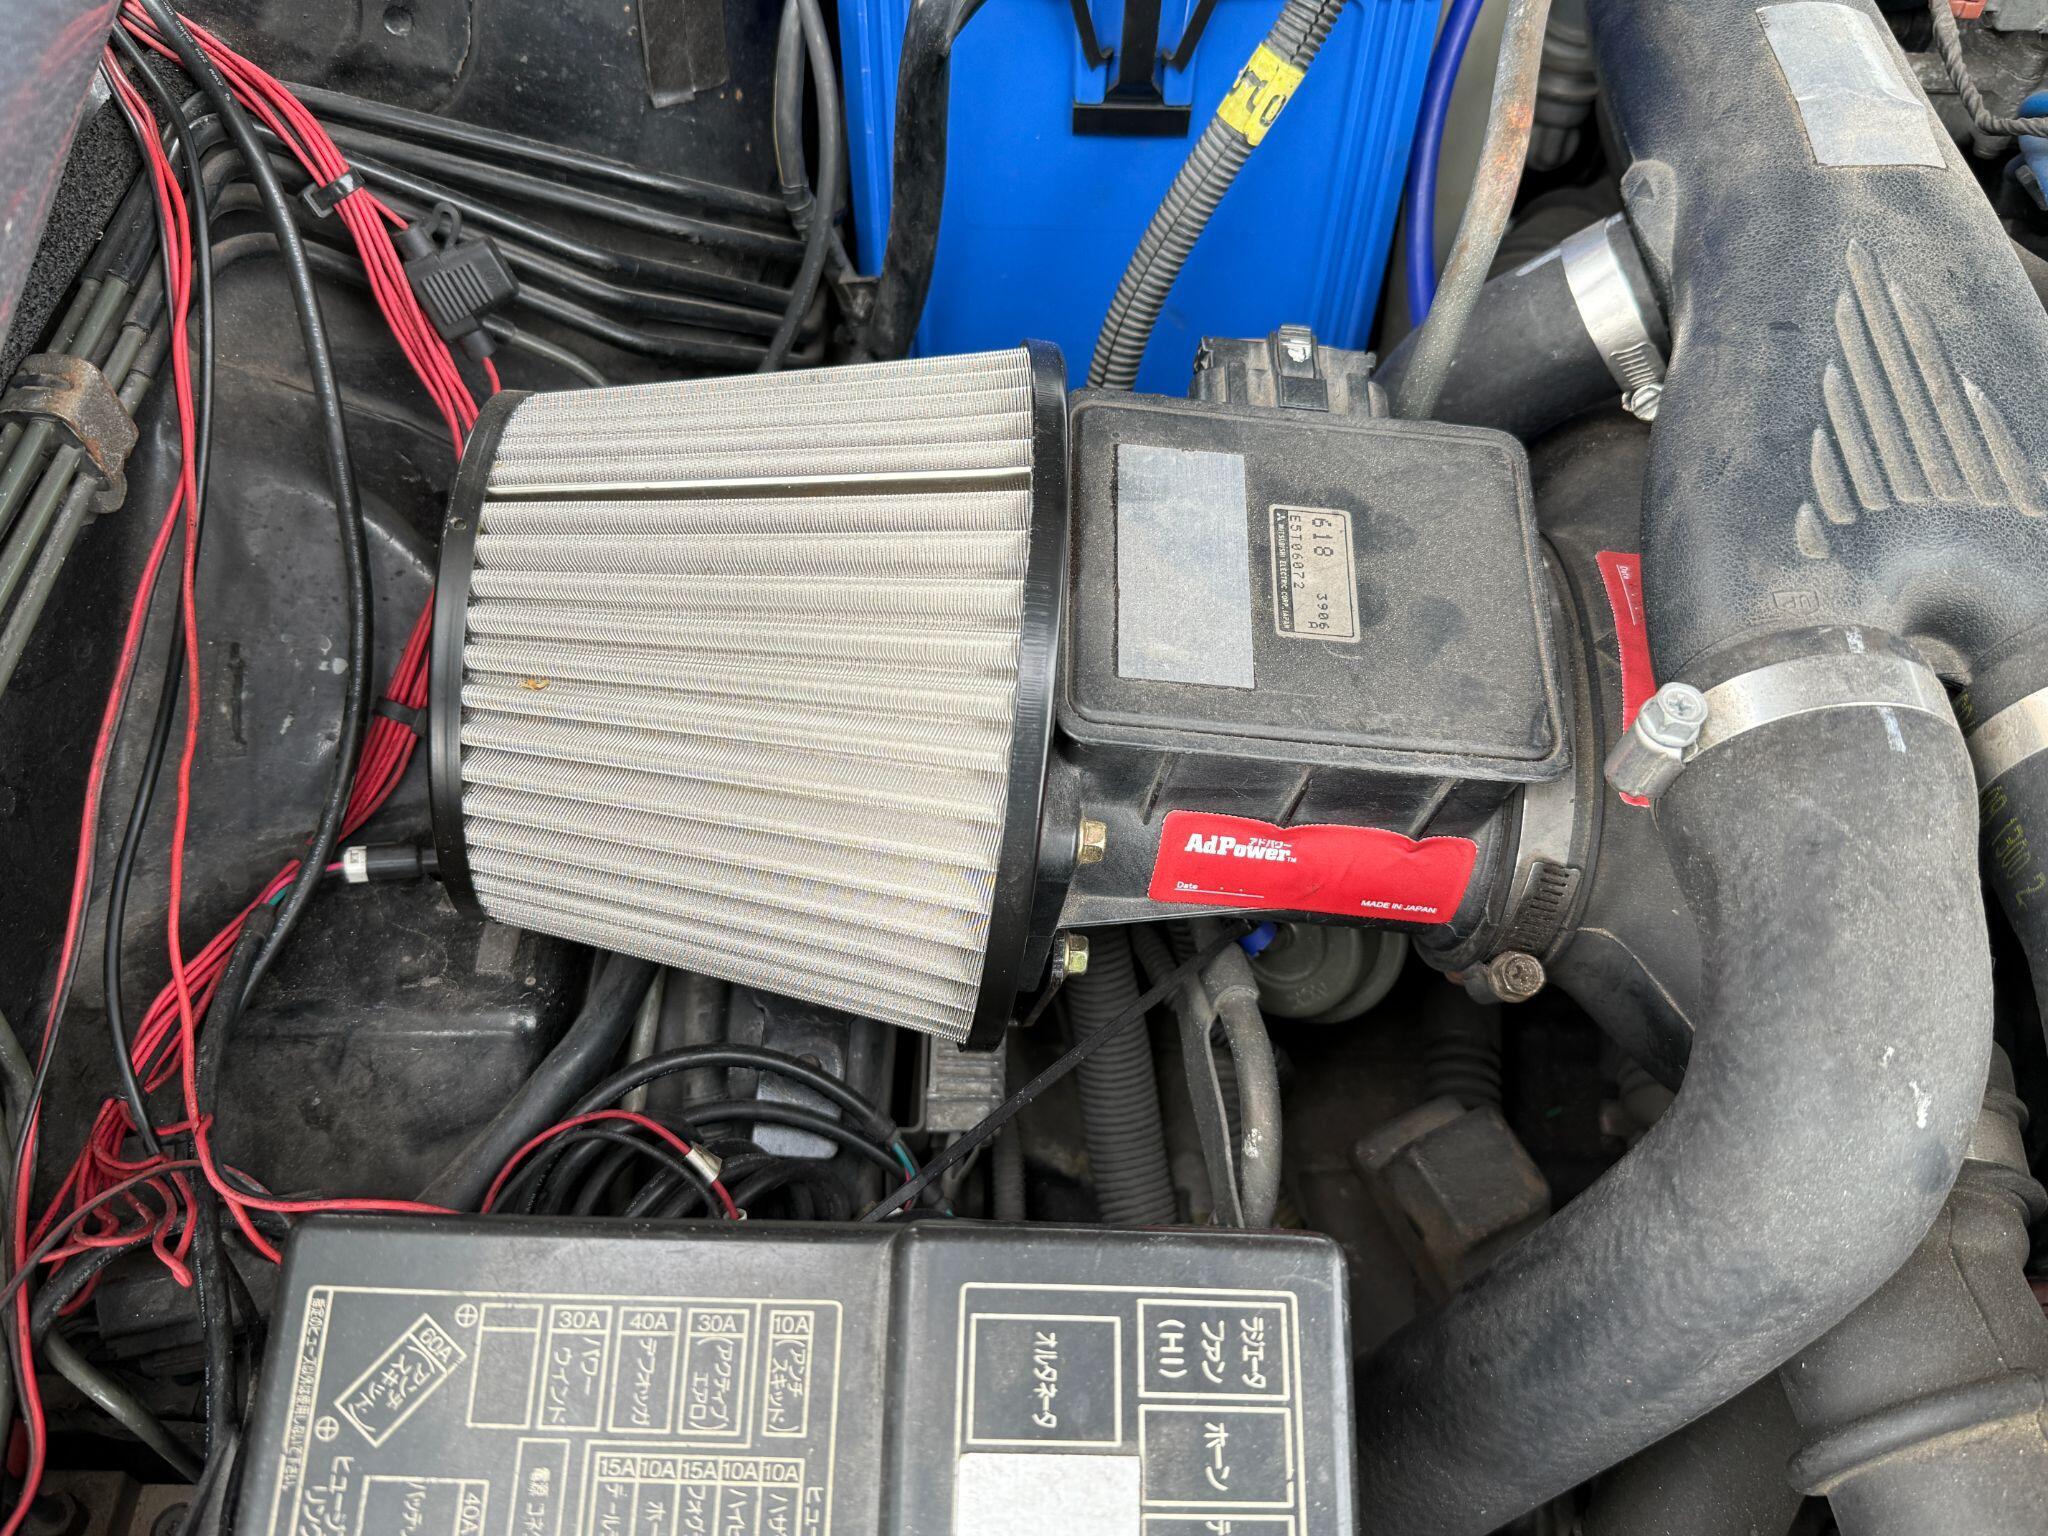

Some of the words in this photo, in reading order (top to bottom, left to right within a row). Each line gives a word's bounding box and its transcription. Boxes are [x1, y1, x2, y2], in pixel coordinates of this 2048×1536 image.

[1311, 517, 1334, 557] 618
[1289, 515, 1305, 590] E5T06072
[1279, 560, 1288, 589] ELECTRIC
[1316, 593, 1330, 630] 3906
[1184, 832, 1291, 862] AdPower
[1249, 837, 1293, 850] アドパワー
[1176, 880, 1199, 891] Date
[1360, 899, 1391, 910] MADE
[1391, 902, 1402, 911] IN
[1402, 904, 1437, 915] JAPAN
[557, 1309, 601, 1330] 30A
[629, 1312, 670, 1332] 40A
[696, 1313, 738, 1333] 30A
[773, 1315, 811, 1335] 10A
[418, 1326, 454, 1364] 60A
[1032, 1330, 1059, 1429] オルタネータ
[600, 1457, 636, 1477] 15A
[640, 1459, 677, 1479] 10A
[682, 1460, 718, 1480] 15A
[723, 1461, 759, 1481] 10A
[763, 1463, 799, 1483] 10A
[1203, 1421, 1231, 1492] ホーン
[459, 1490, 482, 1535] 40A
